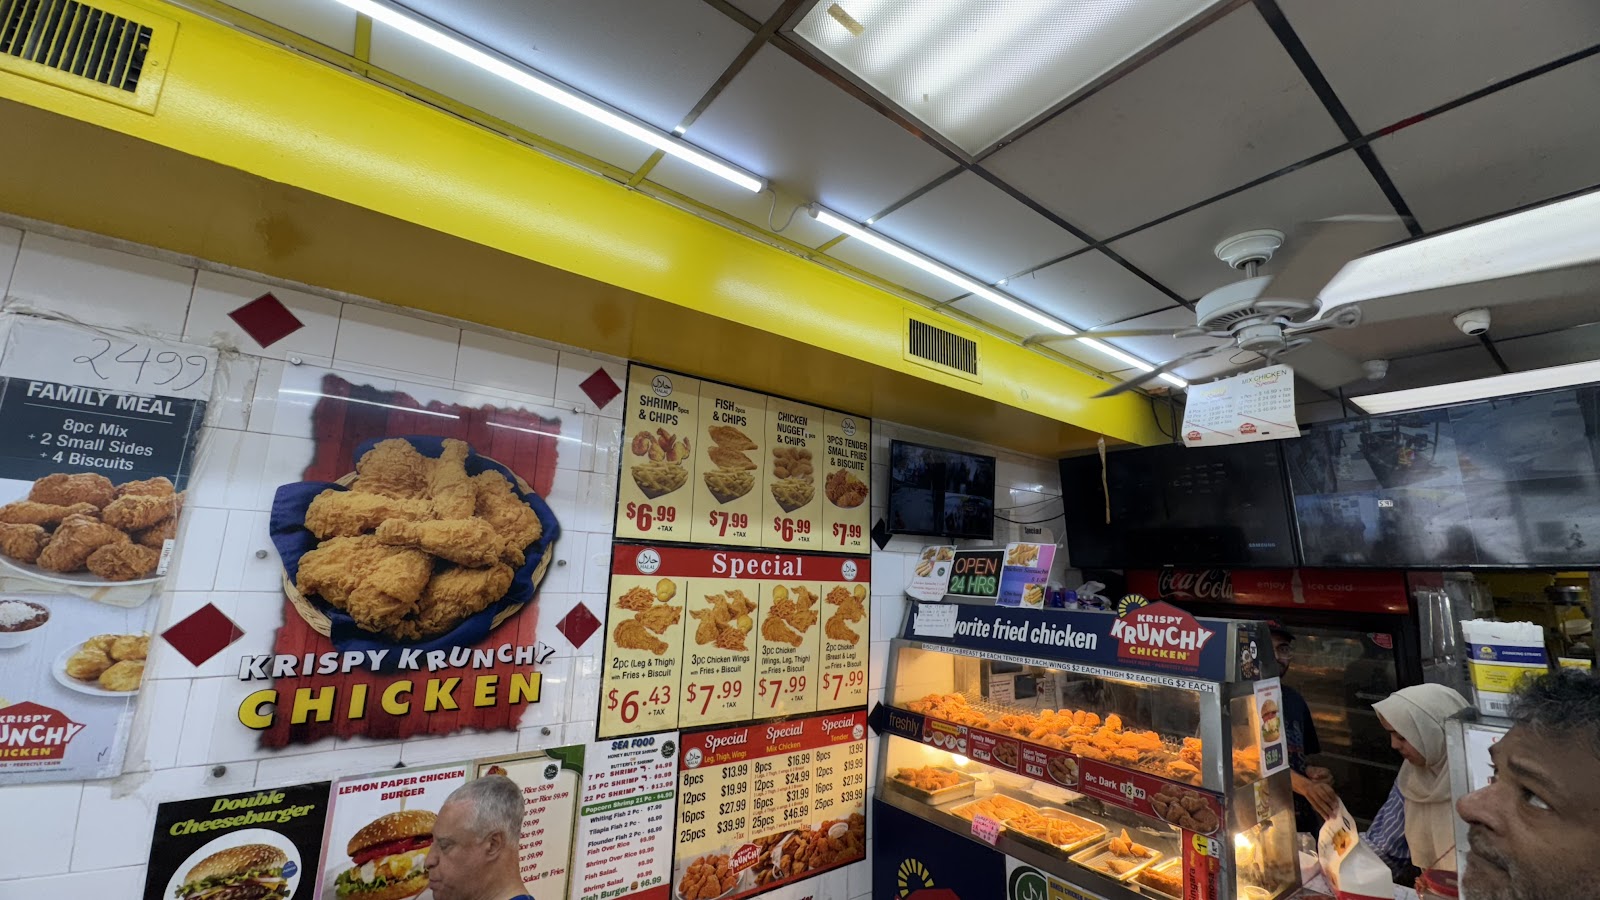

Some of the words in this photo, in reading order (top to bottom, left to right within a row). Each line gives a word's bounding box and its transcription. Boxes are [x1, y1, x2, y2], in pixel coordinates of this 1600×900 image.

[72, 338, 208, 391] 2499
[1253, 369, 1288, 382] CHICKEN
[26, 381, 112, 408] FAMILY
[116, 395, 176, 417] MEAL
[639, 394, 679, 412] SHRIMP
[715, 398, 735, 412] FISH
[638, 408, 647, 420] &
[649, 410, 679, 426] CHIPS
[712, 411, 720, 422] &
[722, 412, 747, 427] CHIPS
[777, 411, 808, 426] CHICKEN
[62, 418, 95, 435] 8pc
[99, 422, 129, 438] Mix
[776, 422, 806, 437] NUGGET
[40, 432, 52, 446] 2
[56, 434, 104, 452] Small
[109, 440, 154, 457] Sides
[776, 434, 783, 443] &
[784, 435, 806, 448] CHIPS
[826, 434, 844, 446] 3PCS
[844, 438, 868, 451] TENDER
[52, 451, 64, 464] 4
[68, 452, 135, 471] Biscuits
[827, 445, 849, 459] SMALL
[850, 450, 868, 461] FRIES
[830, 457, 836, 467] &
[837, 457, 865, 471] BISCUITE
[626, 500, 677, 532] $6.99
[709, 509, 748, 537] $7.99
[773, 515, 811, 543] $6.99
[832, 521, 862, 546] $7.99
[712, 552, 803, 578] Special
[955, 557, 998, 575] OPEN
[950, 575, 965, 593] 24
[967, 575, 997, 595] HRS
[1256, 580, 1286, 591] enjoy
[1307, 582, 1325, 591] ice
[1326, 582, 1354, 592] cold
[1137, 613, 1184, 625] KRISPY
[992, 617, 1030, 643] fried
[1030, 621, 1098, 650] chicken
[1110, 618, 1213, 650] KRUNCHY
[761, 644, 775, 657] 3pc
[825, 642, 837, 652] 2pc
[837, 643, 855, 651] Chicken
[960, 648, 979, 657] BREAST
[986, 652, 1002, 661] EACH
[1129, 646, 1187, 660] CHICKEN
[237, 648, 390, 681] KRISPY
[397, 641, 556, 673] KRUNCHY
[612, 657, 629, 670] 2pc
[630, 659, 645, 669] (Leg
[647, 658, 652, 667] &
[654, 657, 676, 667] Thigh)
[691, 653, 706, 666] 3pc
[706, 656, 731, 664] Chicken
[732, 655, 751, 664] Wings
[794, 654, 811, 664] Thigh)
[1002, 654, 1024, 663] TENDER
[1031, 658, 1047, 667] EACH
[622, 671, 640, 680] Fries
[647, 669, 672, 678] Biscuit
[699, 666, 715, 675] Fries
[720, 665, 742, 674] Biscuit
[767, 666, 782, 674] Fries
[786, 665, 805, 673] Biscuit
[1048, 661, 1071, 671] WINGS
[1071, 663, 1080, 672] $2
[1081, 665, 1101, 675] EACH
[1102, 668, 1125, 680] THIGH
[1126, 672, 1135, 680] $2
[1135, 673, 1157, 684] EACH
[758, 675, 807, 709] $7.99
[822, 670, 864, 701] $7.99
[1157, 676, 1174, 686] LEG
[1175, 679, 1186, 689] $2
[1188, 681, 1214, 693] EACH
[237, 671, 543, 731] CHICKEN
[607, 685, 672, 724] $6.43
[686, 680, 743, 716] $7.99
[765, 721, 804, 744] Special
[821, 713, 855, 736] Special
[888, 712, 920, 737] freshly
[611, 739, 629, 751] SEA
[631, 736, 656, 749] FOOD
[704, 728, 749, 754] Special
[831, 733, 849, 742] Tender
[0, 747, 52, 757] ICKEN
[731, 750, 747, 759] Wings
[766, 745, 778, 753] Mix
[778, 741, 801, 752] Chicken
[754, 761, 772, 774] 8pcs
[787, 752, 811, 767] $16.99
[815, 750, 831, 763] 8pcs
[683, 773, 704, 787] 8pcs
[722, 763, 748, 779] $13.99
[815, 766, 833, 778] 12pcs
[843, 757, 863, 772] $19.99
[338, 782, 379, 796] LEMON
[380, 776, 417, 789] PAPER
[418, 769, 465, 783] CHICKEN
[587, 784, 597, 792] 15
[611, 777, 639, 787] SHRIMP
[754, 779, 775, 792] 12pcs
[785, 770, 810, 785] $24.99
[815, 782, 833, 795] 16pcs
[842, 773, 863, 787] $27.99
[1098, 775, 1118, 791] Dark
[210, 790, 286, 813] Double
[380, 787, 425, 801] BURGER
[682, 791, 706, 806] 12pcs
[720, 781, 748, 798] $19.99
[753, 797, 774, 811] 16pcs
[786, 787, 810, 803] $31.99
[814, 798, 834, 811] 25pcs
[840, 788, 863, 803] $39.99
[585, 802, 612, 814] Popcorn
[612, 797, 635, 809] Shrimp
[681, 810, 706, 824] 16pcs
[719, 798, 747, 816] $27.99
[169, 804, 316, 836] Cheeseburger
[752, 815, 775, 829] 25pcs
[783, 804, 809, 822] $46.99
[679, 828, 706, 843] 25pcs
[716, 816, 746, 835] $39.99
[600, 885, 629, 899] Burger
